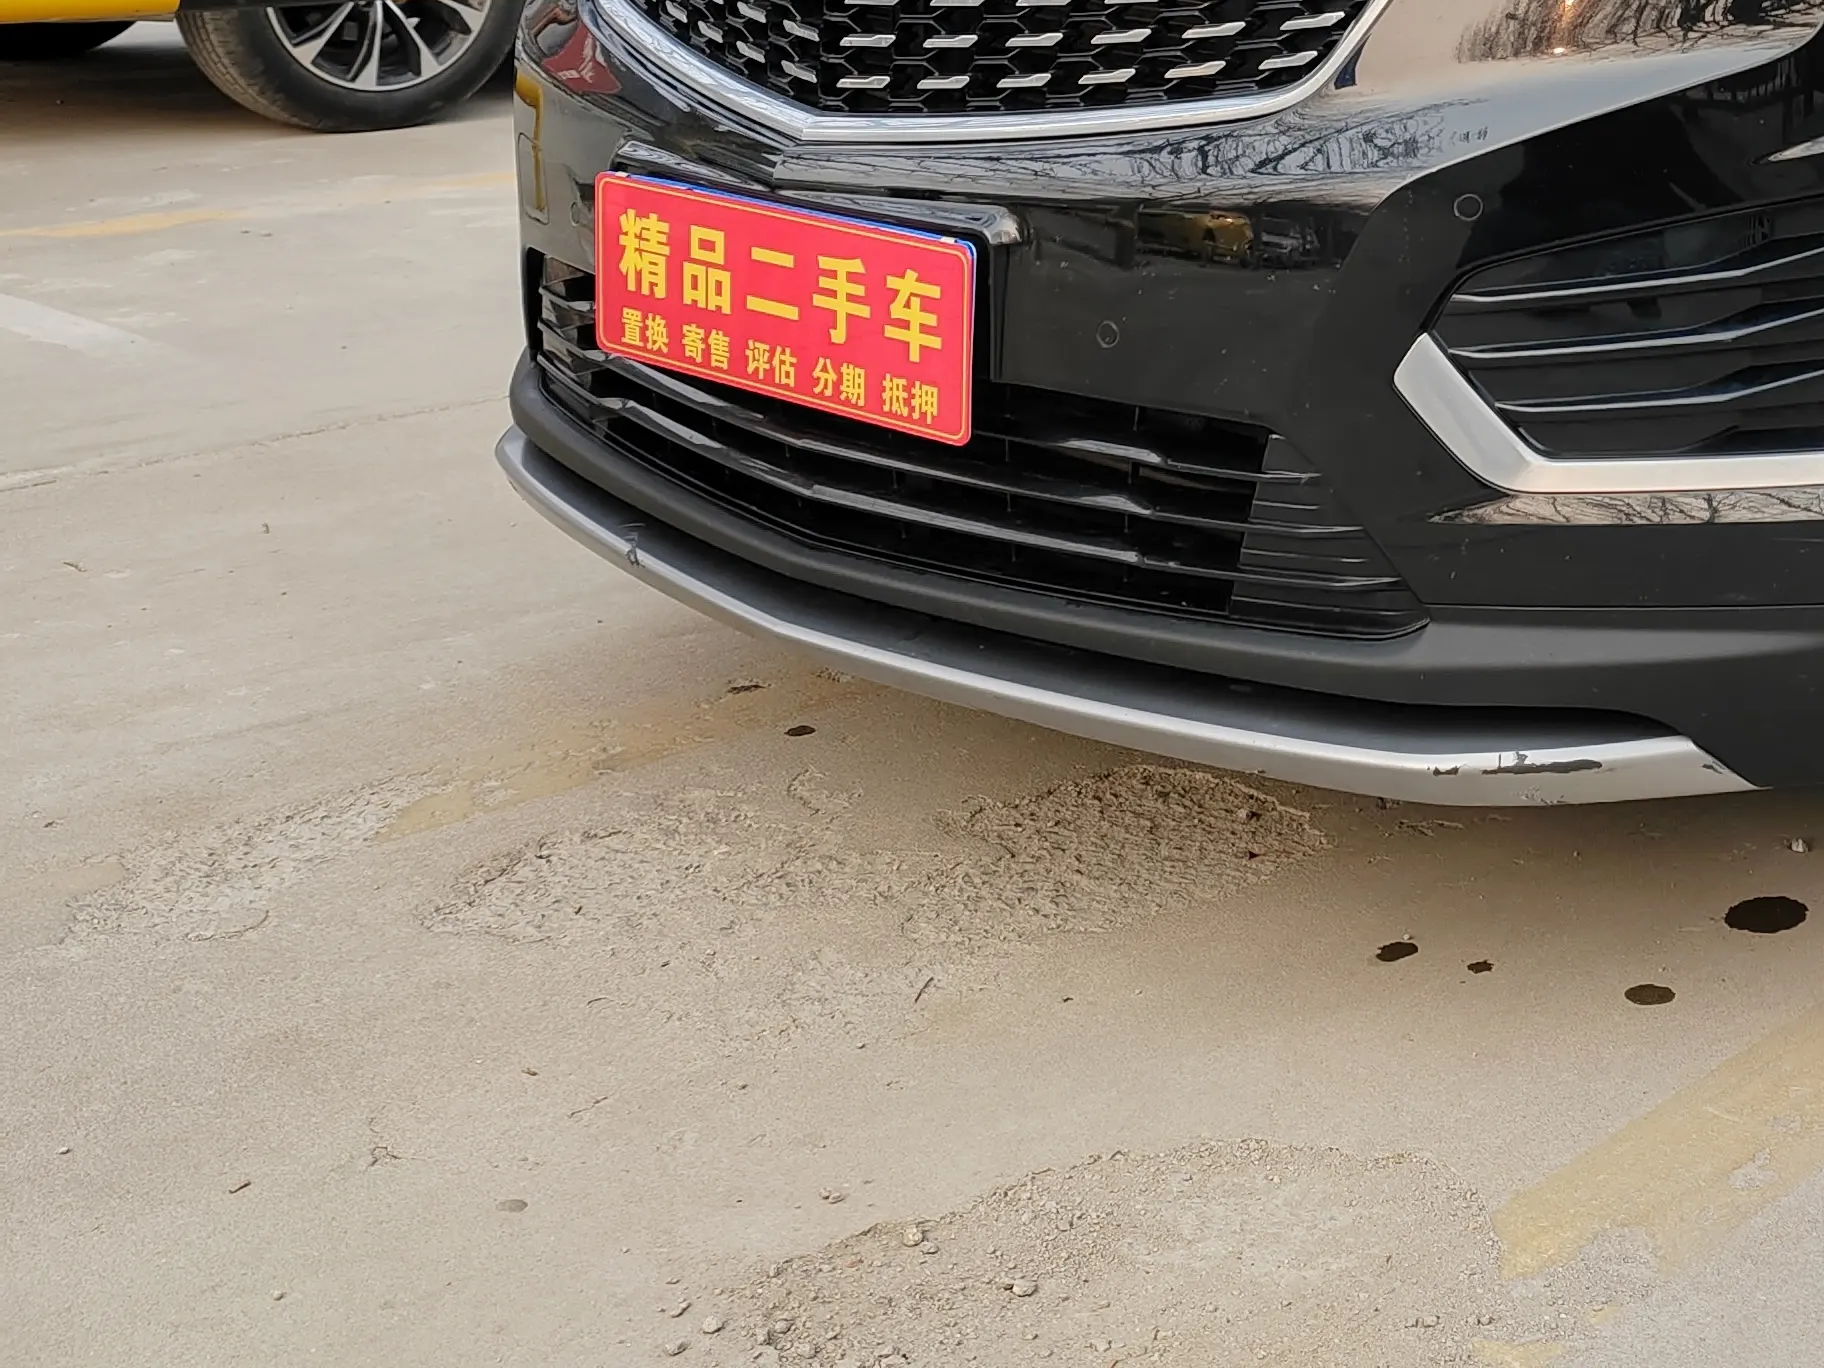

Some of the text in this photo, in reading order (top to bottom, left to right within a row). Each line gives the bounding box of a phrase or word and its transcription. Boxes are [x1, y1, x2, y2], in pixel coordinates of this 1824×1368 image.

[618, 208, 942, 363] 精品二手车
[621, 307, 939, 424] 置换 寄售 评估 分期 抵押
